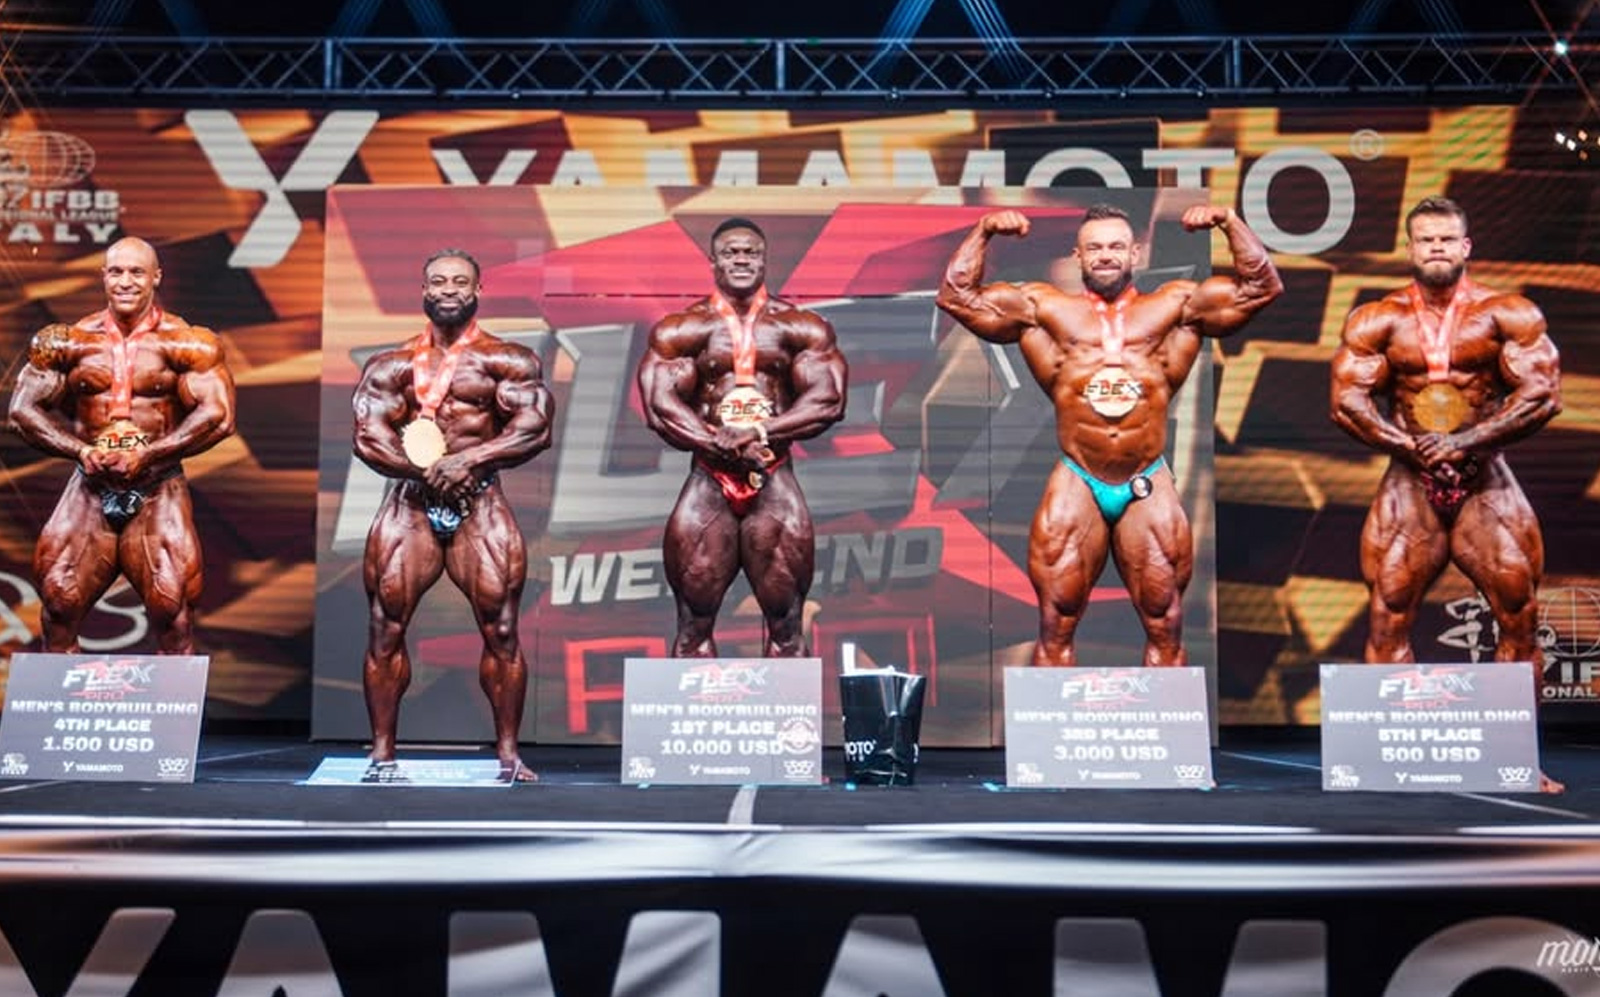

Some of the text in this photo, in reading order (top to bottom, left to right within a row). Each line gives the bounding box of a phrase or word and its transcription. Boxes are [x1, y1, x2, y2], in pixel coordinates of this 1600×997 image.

[31, 190, 119, 209] IFBB
[0, 222, 118, 243] ALY
[1083, 381, 1144, 398] FLEX
[62, 664, 155, 688] FLEX
[678, 666, 769, 692] FLEX
[1061, 674, 1153, 698] FLEX
[1378, 672, 1477, 699] FLEX
[11, 699, 199, 714] MEN'S BODYBUILDING
[630, 703, 817, 716] MEN'S BODYBUILDING
[1013, 710, 1204, 723] MEN'S BODYBUILDING
[1328, 710, 1531, 724] MEN'S BODYBUILDING
[54, 718, 153, 732] 4TH PLACE
[670, 720, 776, 735] 1ST PLACE
[1061, 727, 1160, 741] 3RD PLACE
[1378, 727, 1484, 742] 5TH PLACE
[43, 736, 155, 752] 1.500 USD
[660, 739, 785, 755] 10.000 USD
[1053, 745, 1169, 761] 3.000 USD
[1381, 746, 1482, 763] 500 USD
